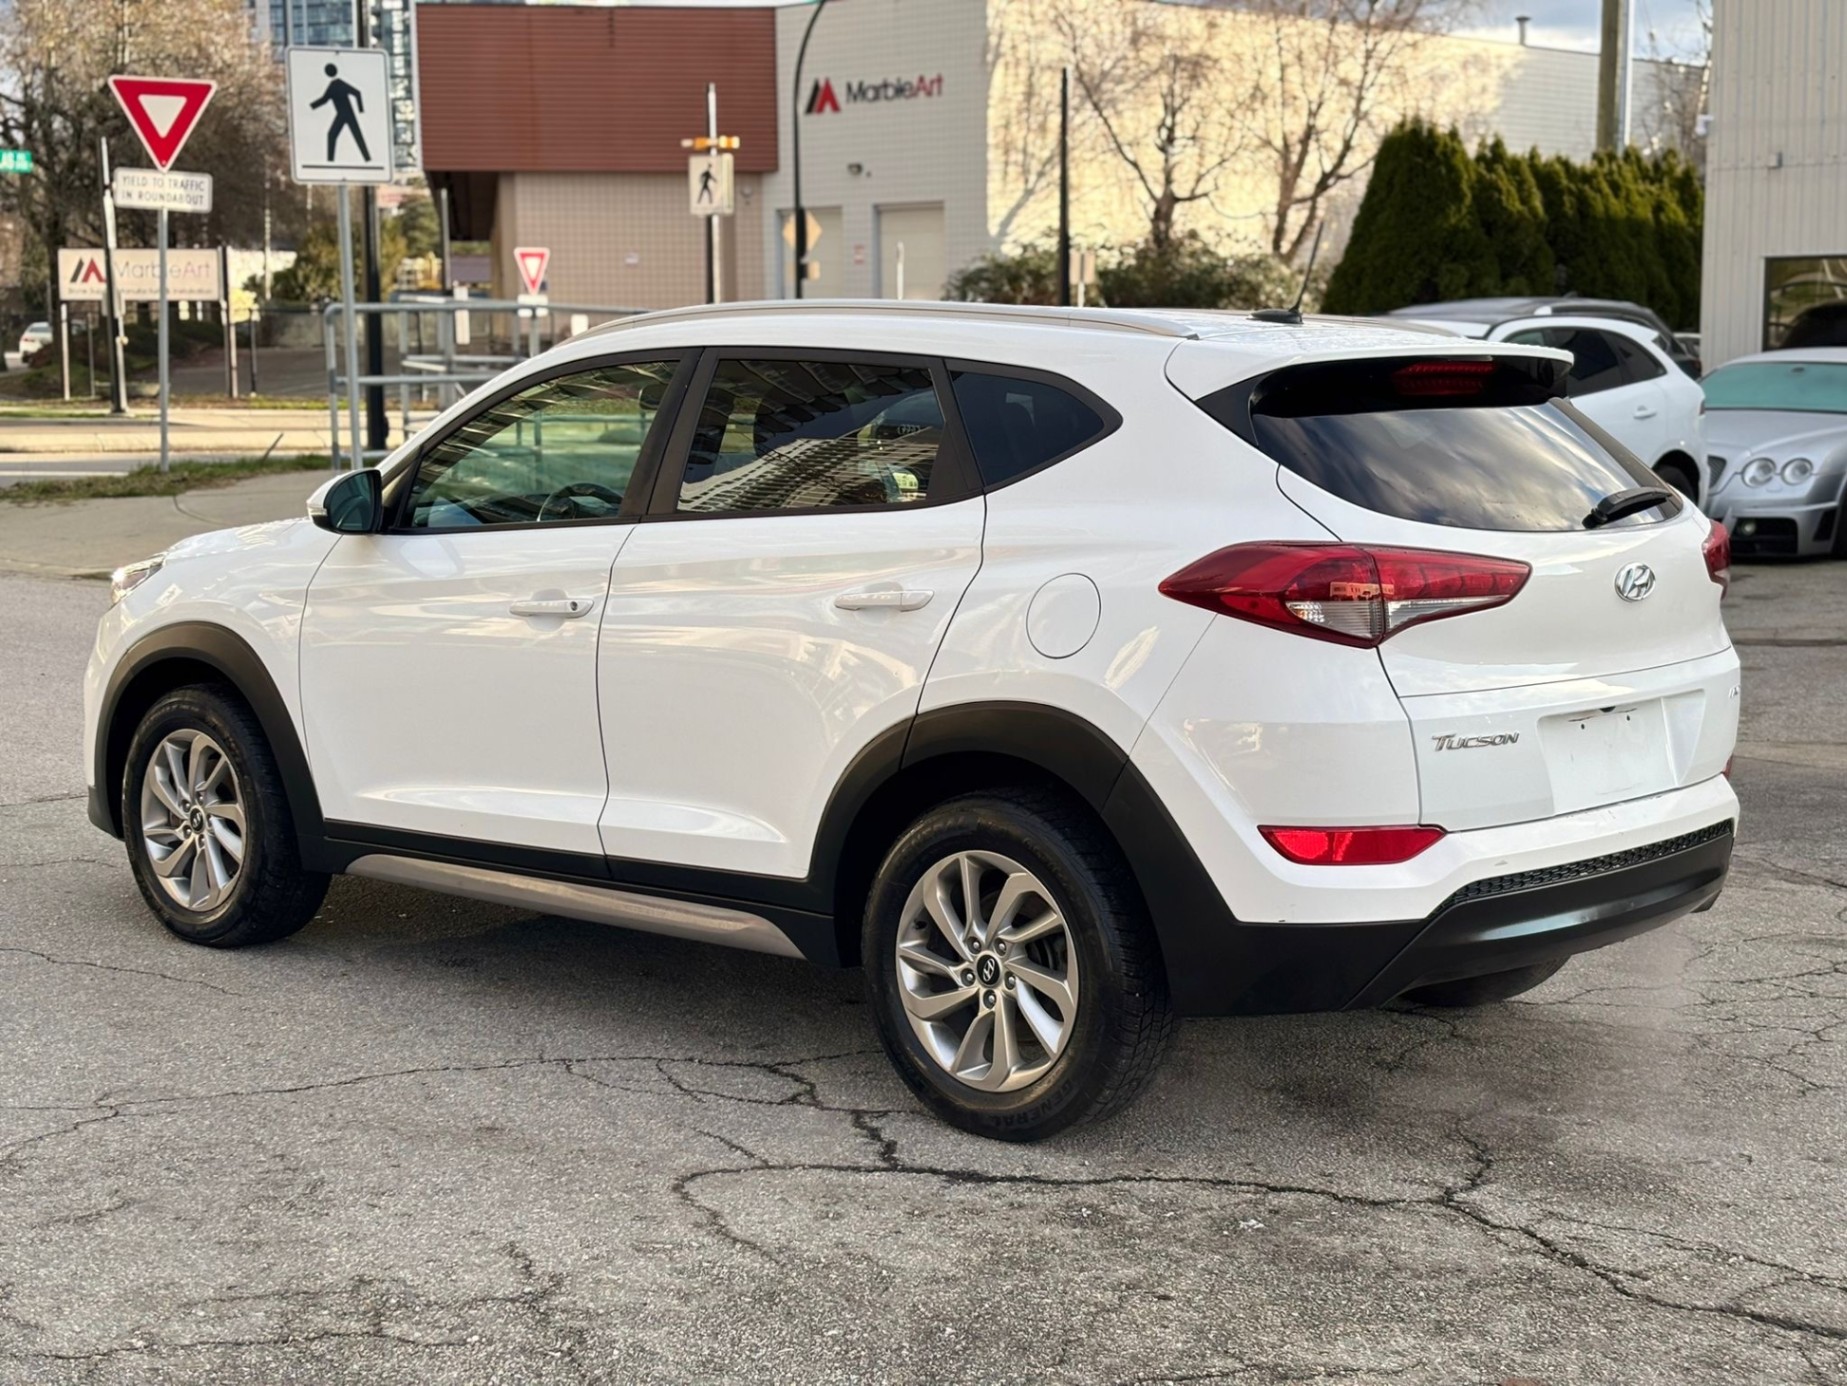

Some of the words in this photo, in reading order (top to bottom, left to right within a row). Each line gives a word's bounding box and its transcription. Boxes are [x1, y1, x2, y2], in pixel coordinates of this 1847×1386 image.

[846, 73, 944, 103] MarbleArt
[122, 175, 148, 187] YIELD
[152, 177, 164, 189] TO
[168, 178, 205, 192] TRAFFIC
[121, 190, 132, 200] IN
[138, 190, 204, 206] ROUNDABOUT
[114, 260, 211, 279] MarbeArt
